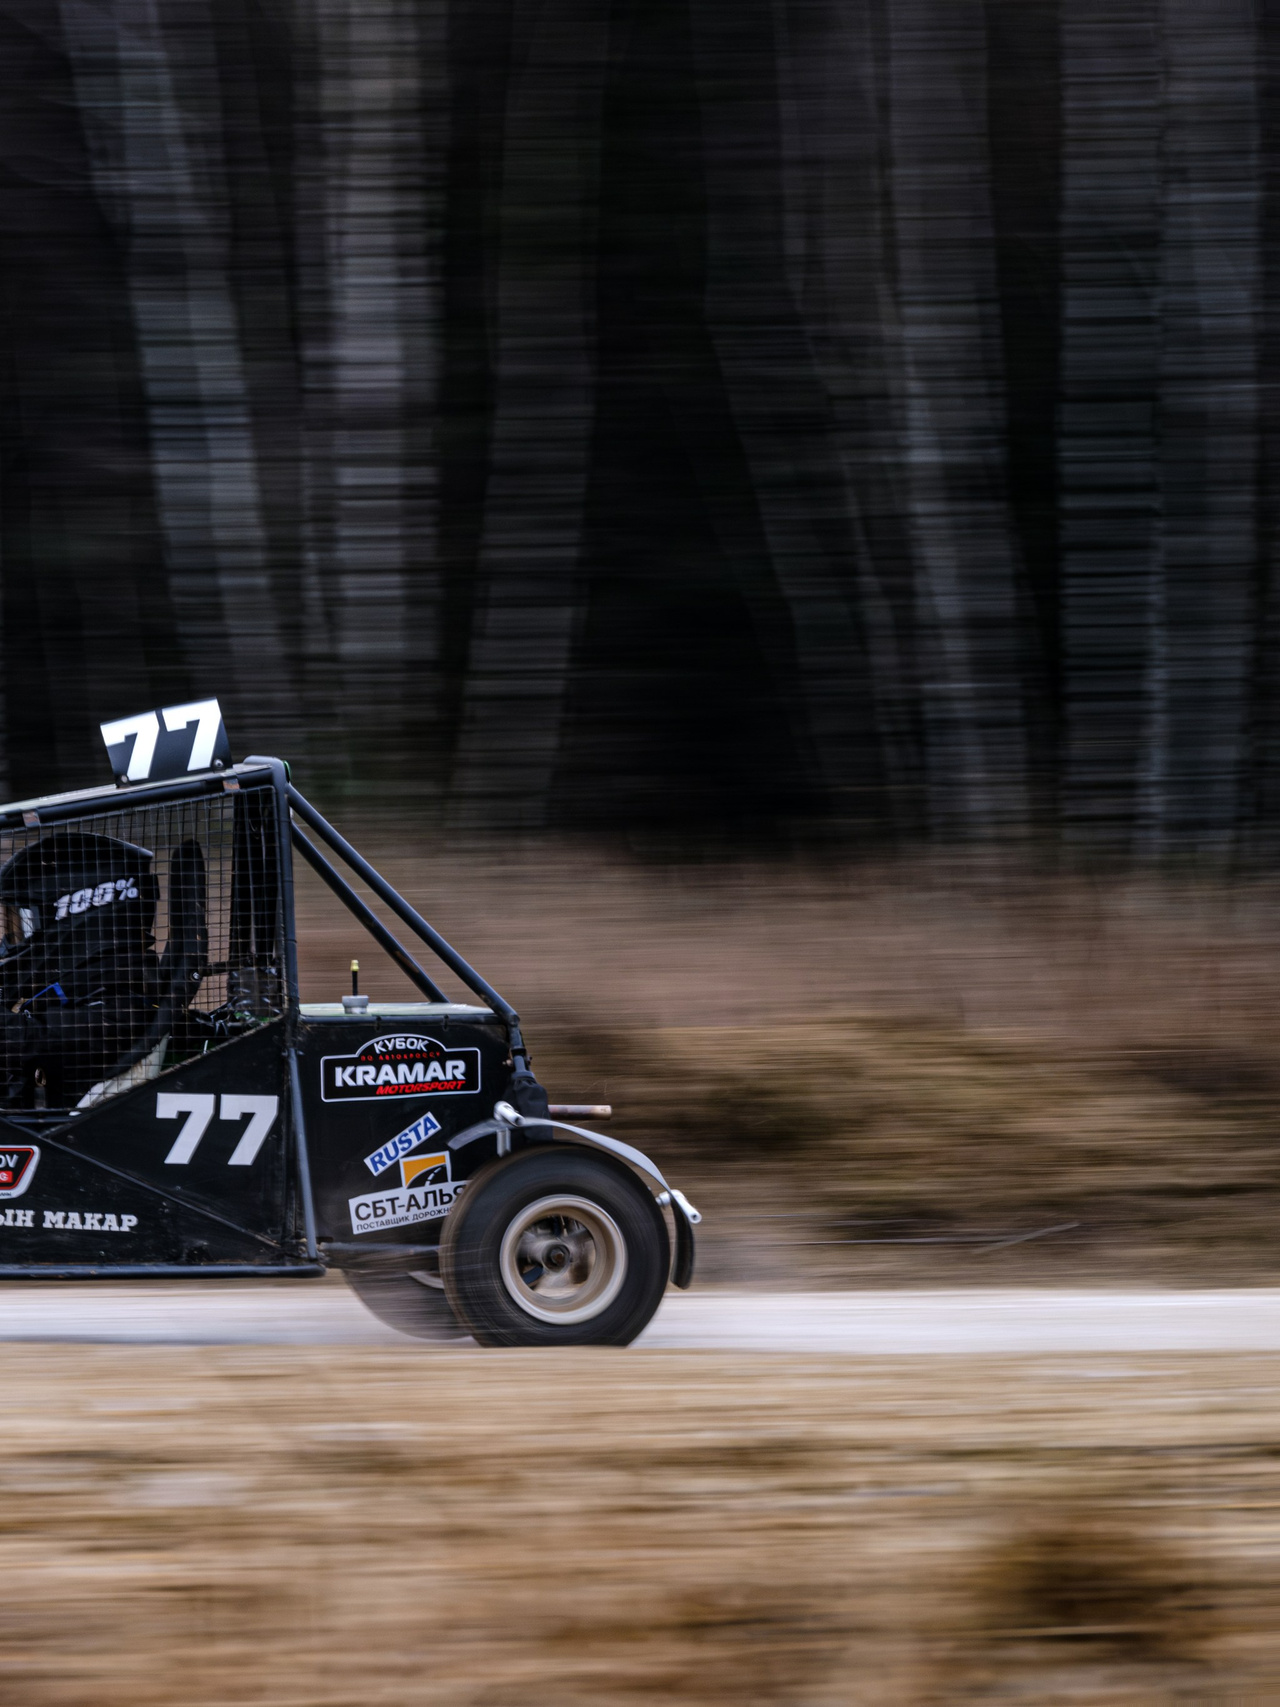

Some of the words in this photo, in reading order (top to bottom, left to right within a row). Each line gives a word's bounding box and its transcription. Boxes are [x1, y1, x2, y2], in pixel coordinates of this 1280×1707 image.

[100, 698, 222, 781] 77
[53, 877, 139, 920] 100%
[374, 1037, 429, 1054] КУБОК
[334, 1059, 466, 1087] KRAMAR
[375, 1080, 466, 1095] MOTORSPORT
[157, 1093, 279, 1166] 77
[369, 1116, 439, 1173] RUSTA
[42, 1210, 139, 1232] МАКАР
[356, 1215, 410, 1231] ПОСТАВЩИК
